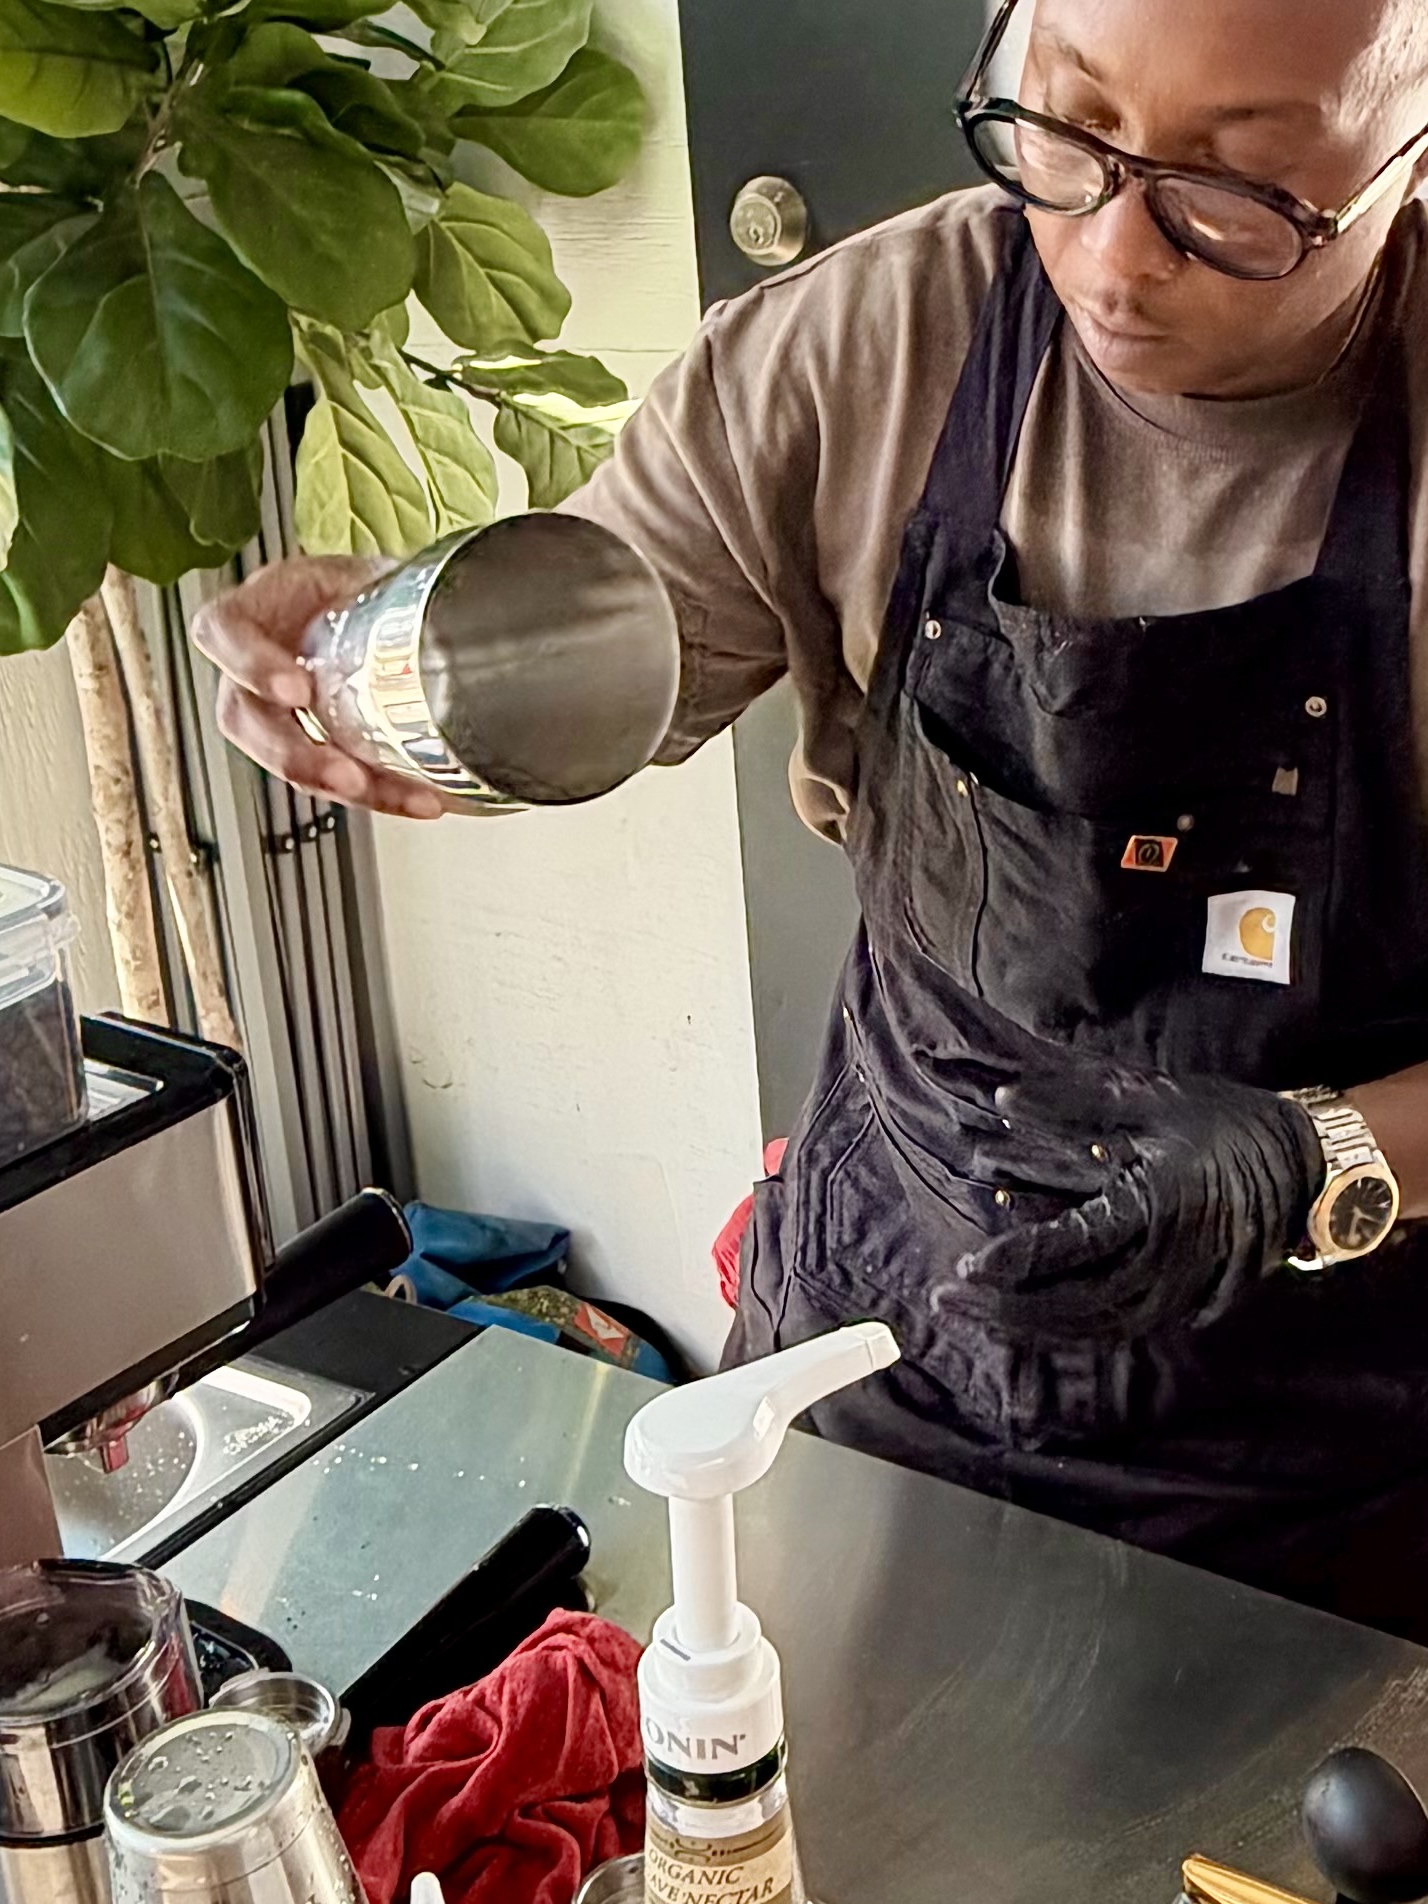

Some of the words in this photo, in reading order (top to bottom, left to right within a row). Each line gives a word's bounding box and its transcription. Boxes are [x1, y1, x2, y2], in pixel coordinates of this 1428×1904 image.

[646, 1717, 738, 1760] ONIN
[648, 1848, 744, 1886] ORGANIC
[650, 1874, 680, 1902] AVE
